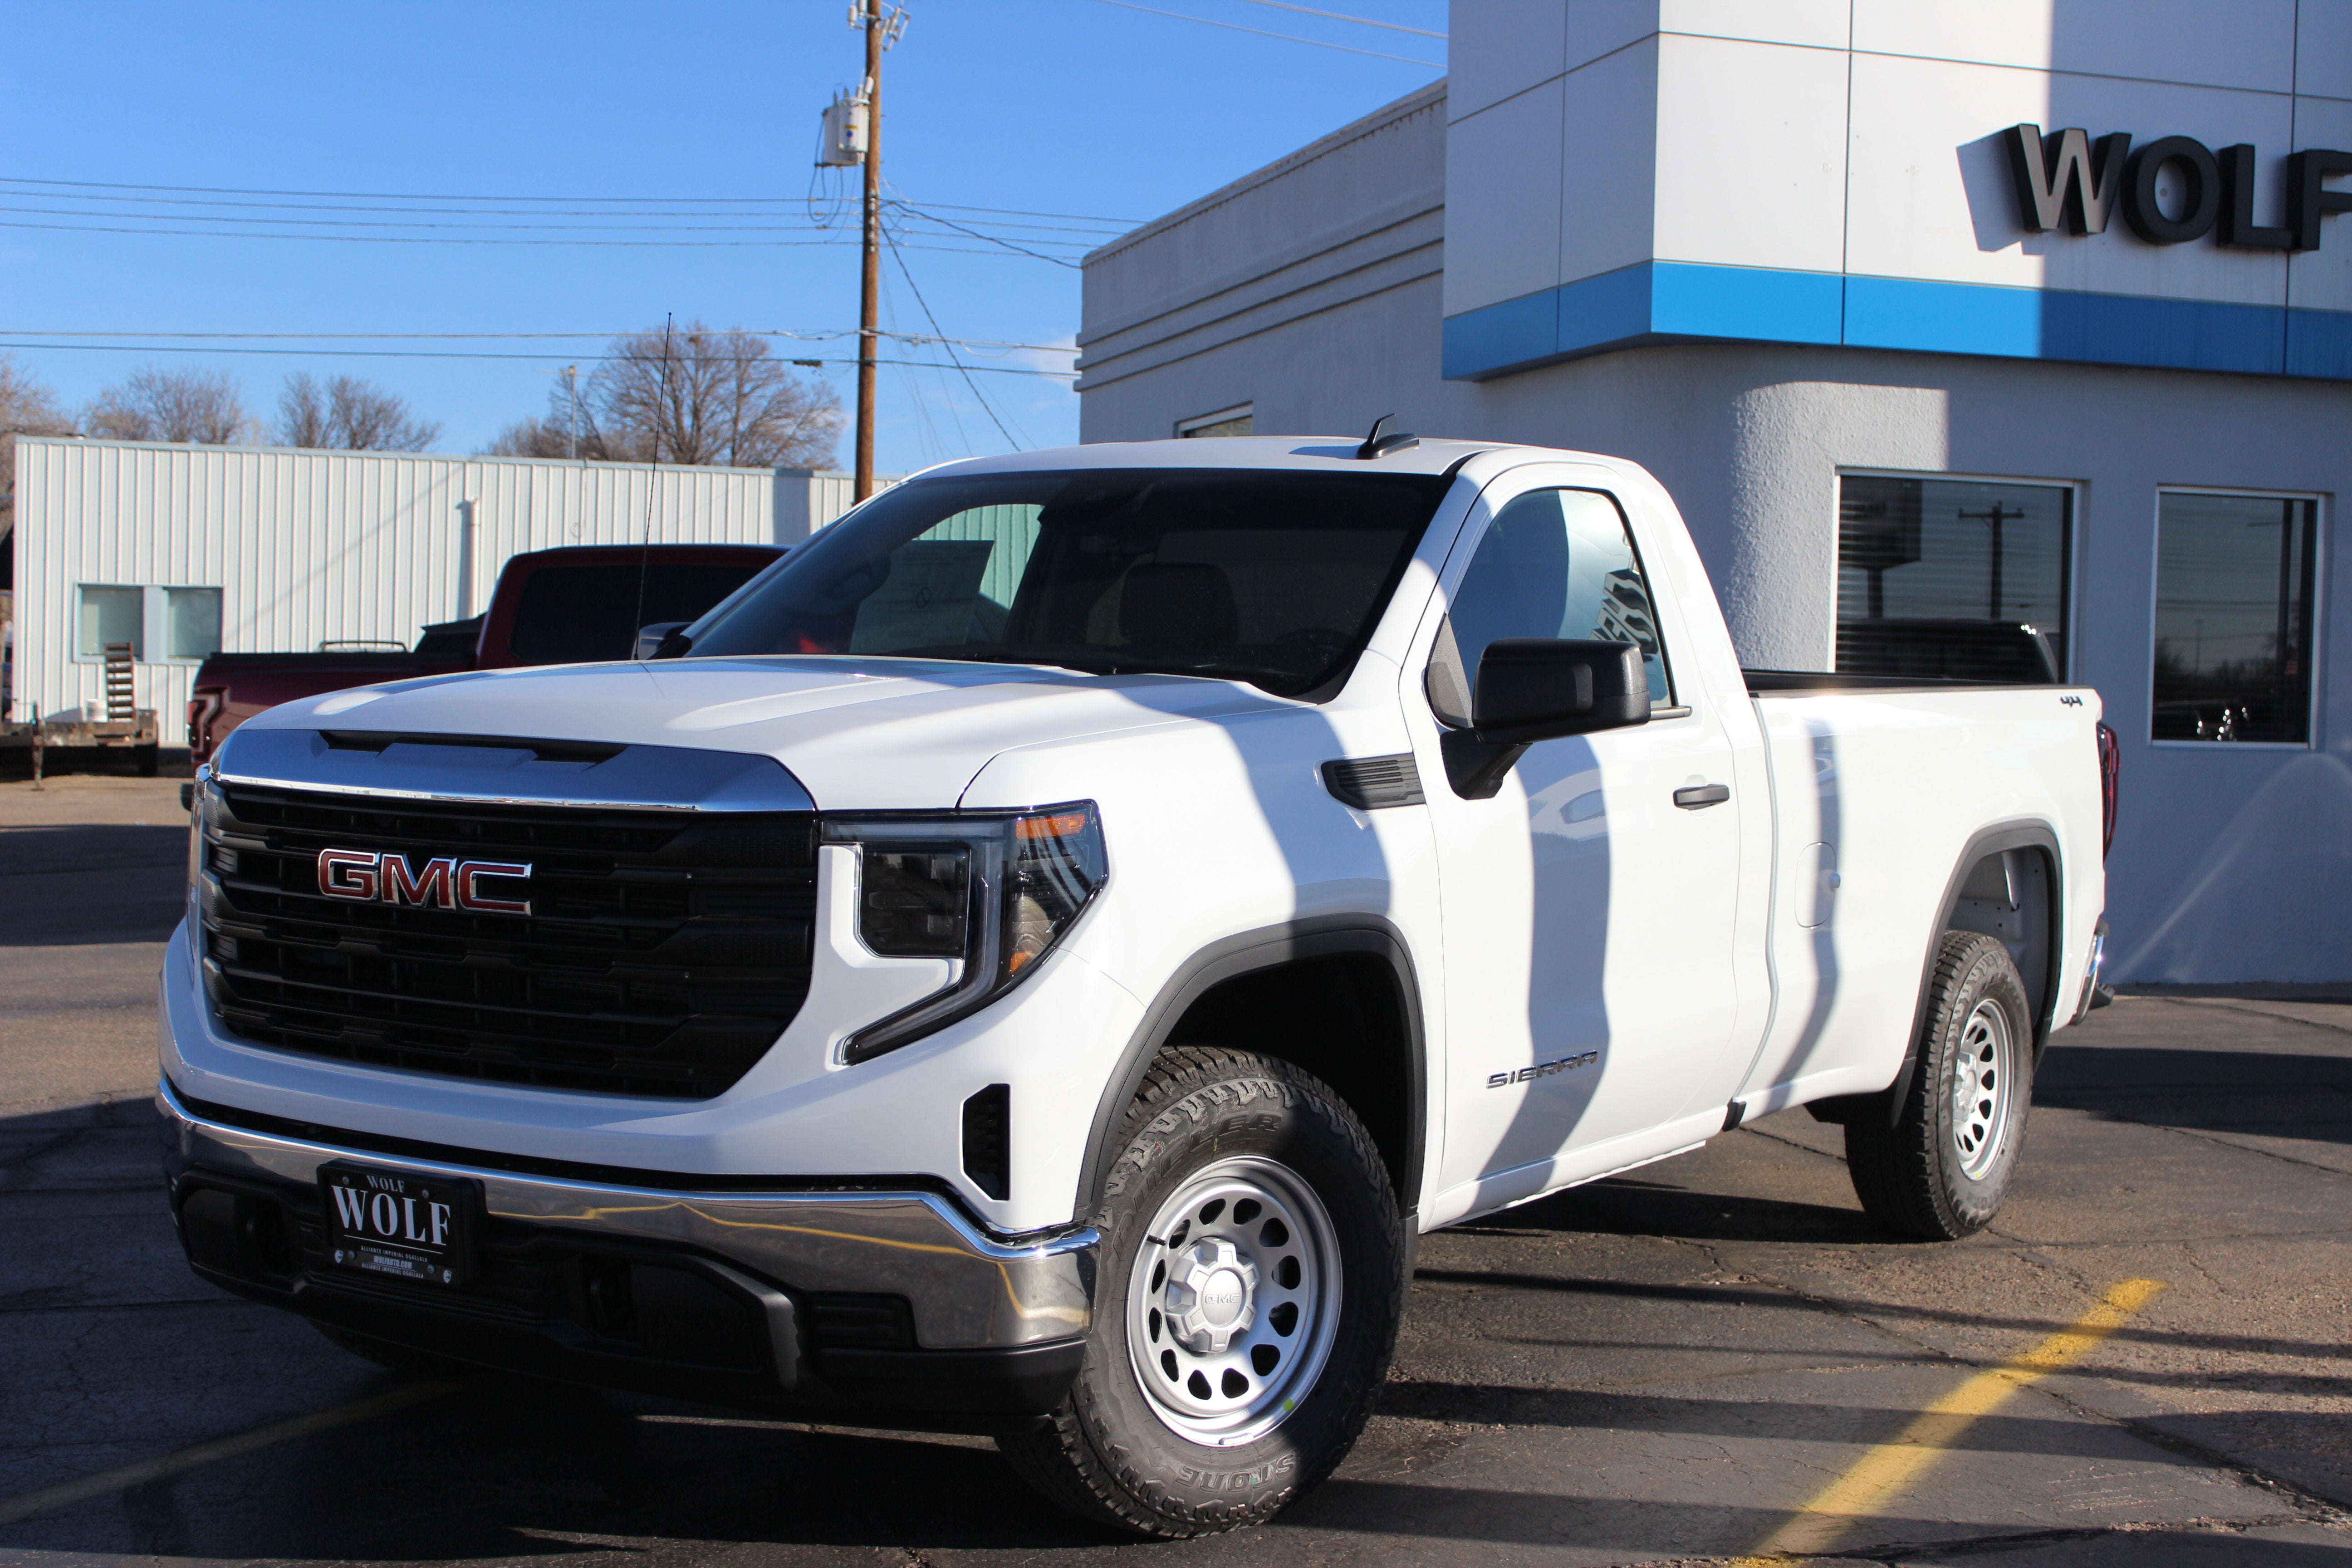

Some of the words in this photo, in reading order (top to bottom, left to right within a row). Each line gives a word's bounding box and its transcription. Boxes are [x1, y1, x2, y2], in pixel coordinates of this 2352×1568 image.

[2005, 122, 2352, 254] WOLF
[318, 848, 532, 916] GMC
[1486, 1049, 1598, 1089] SIERRA
[366, 1175, 405, 1193] WOLF
[331, 1185, 451, 1246] WOLF
[361, 1245, 382, 1254] ALLIANCE
[382, 1250, 404, 1258] IMPERIAL
[405, 1254, 428, 1263] OGALLALA
[373, 1255, 412, 1269] WOLFAUTO.COM
[361, 1263, 381, 1271] ALLIANCE
[402, 1270, 424, 1279] OGALLALA
[1205, 1292, 1241, 1304] GMC
